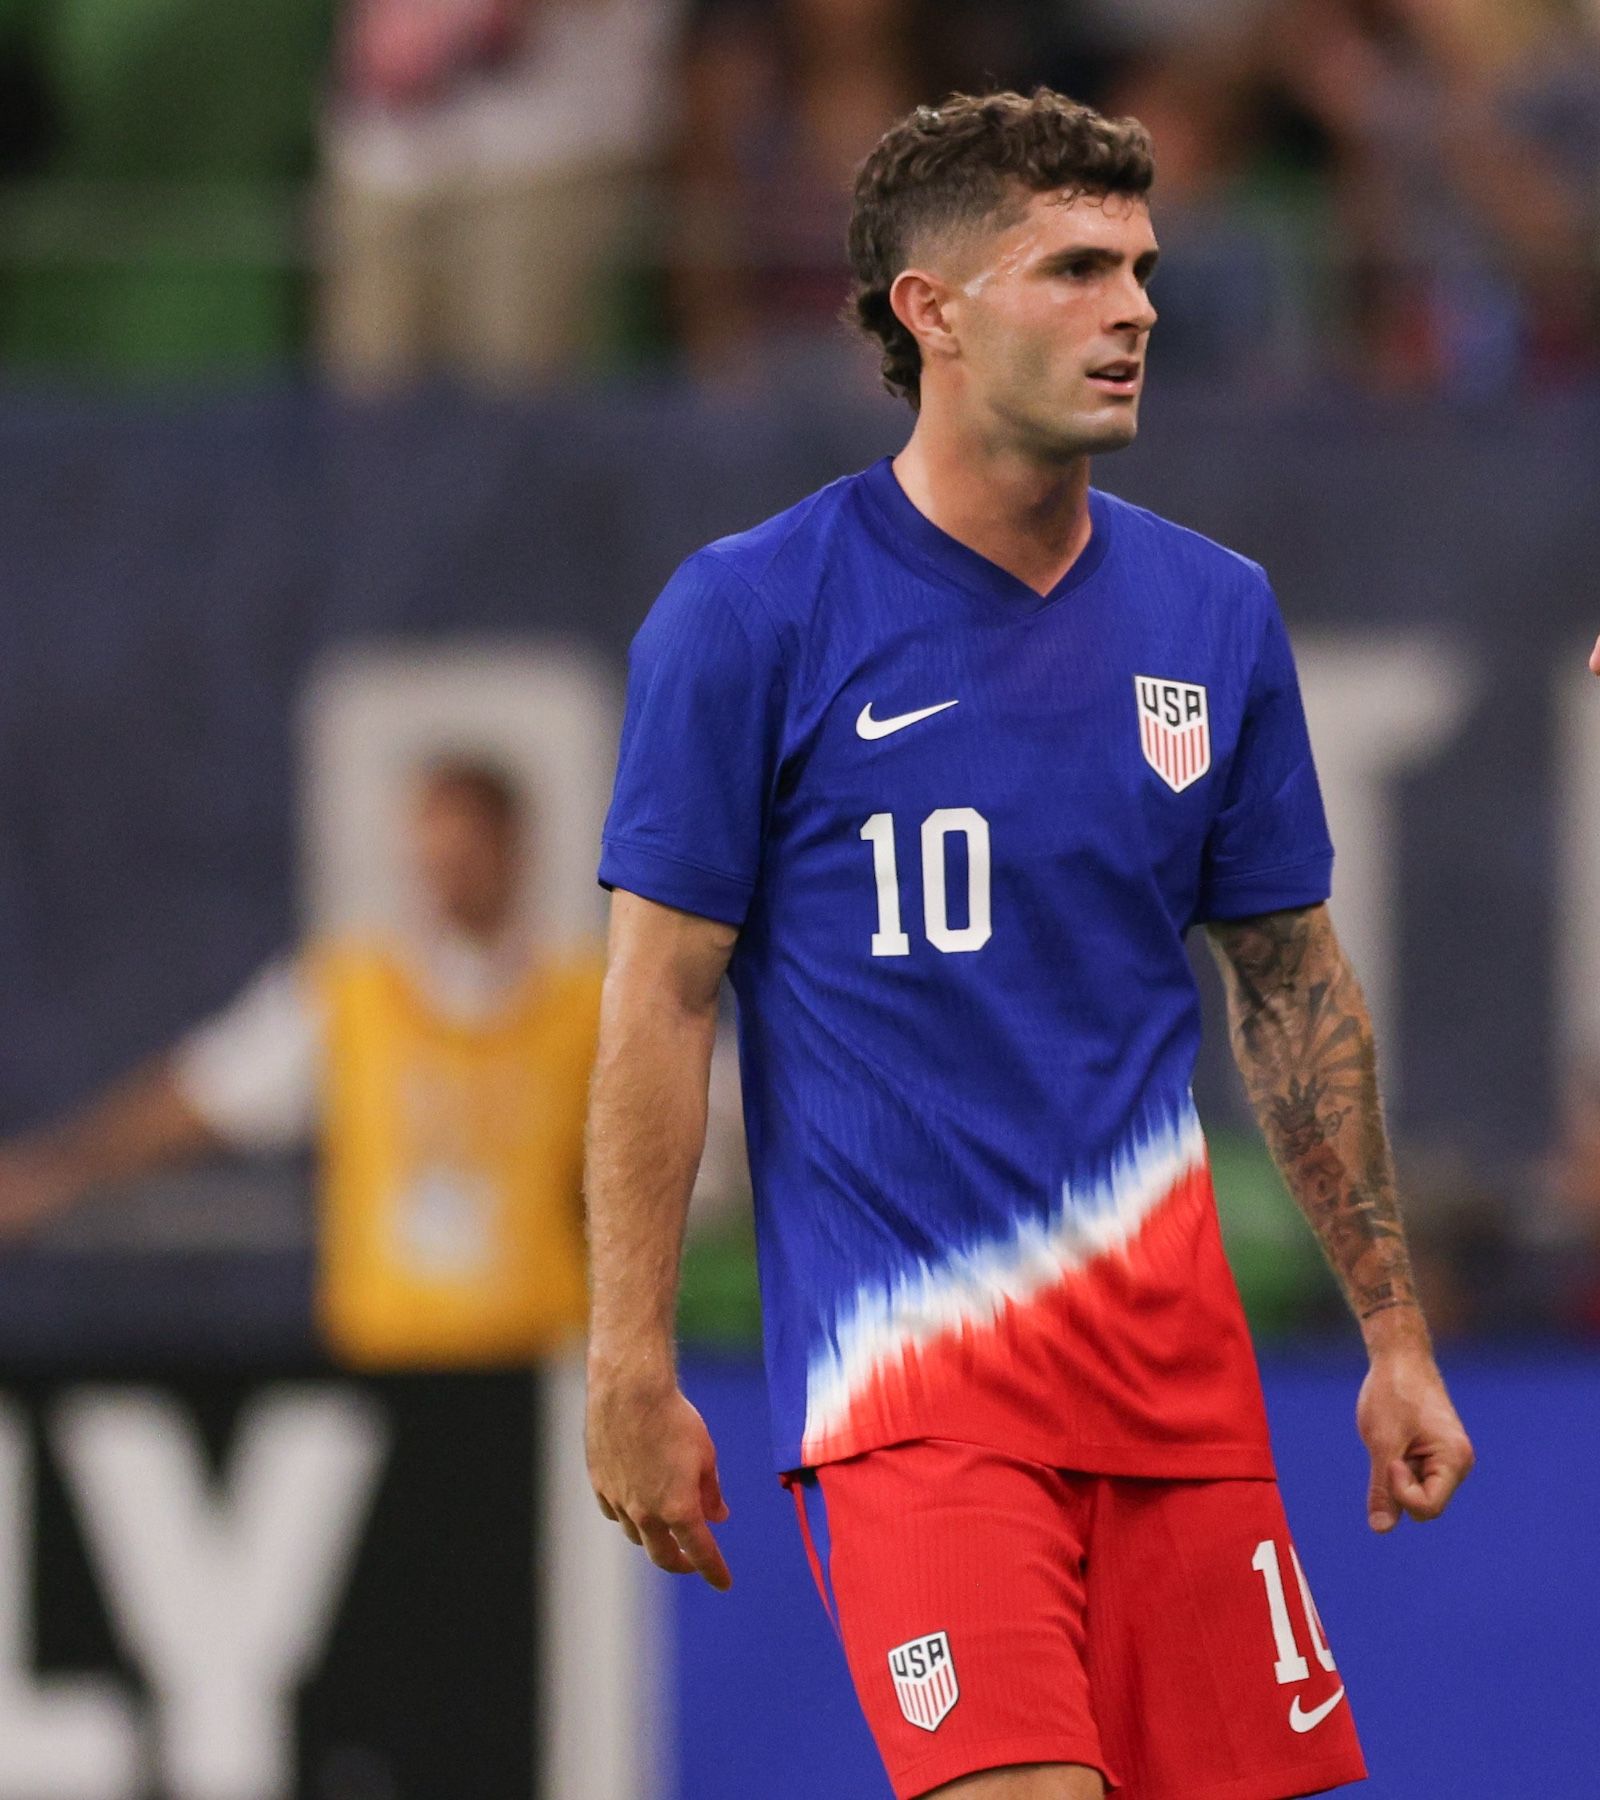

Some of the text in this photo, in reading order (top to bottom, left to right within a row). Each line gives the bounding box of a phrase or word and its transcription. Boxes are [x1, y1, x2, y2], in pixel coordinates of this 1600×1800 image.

[1141, 682, 1202, 727] USA
[860, 807, 993, 957] 10
[892, 1637, 945, 1679] USA
